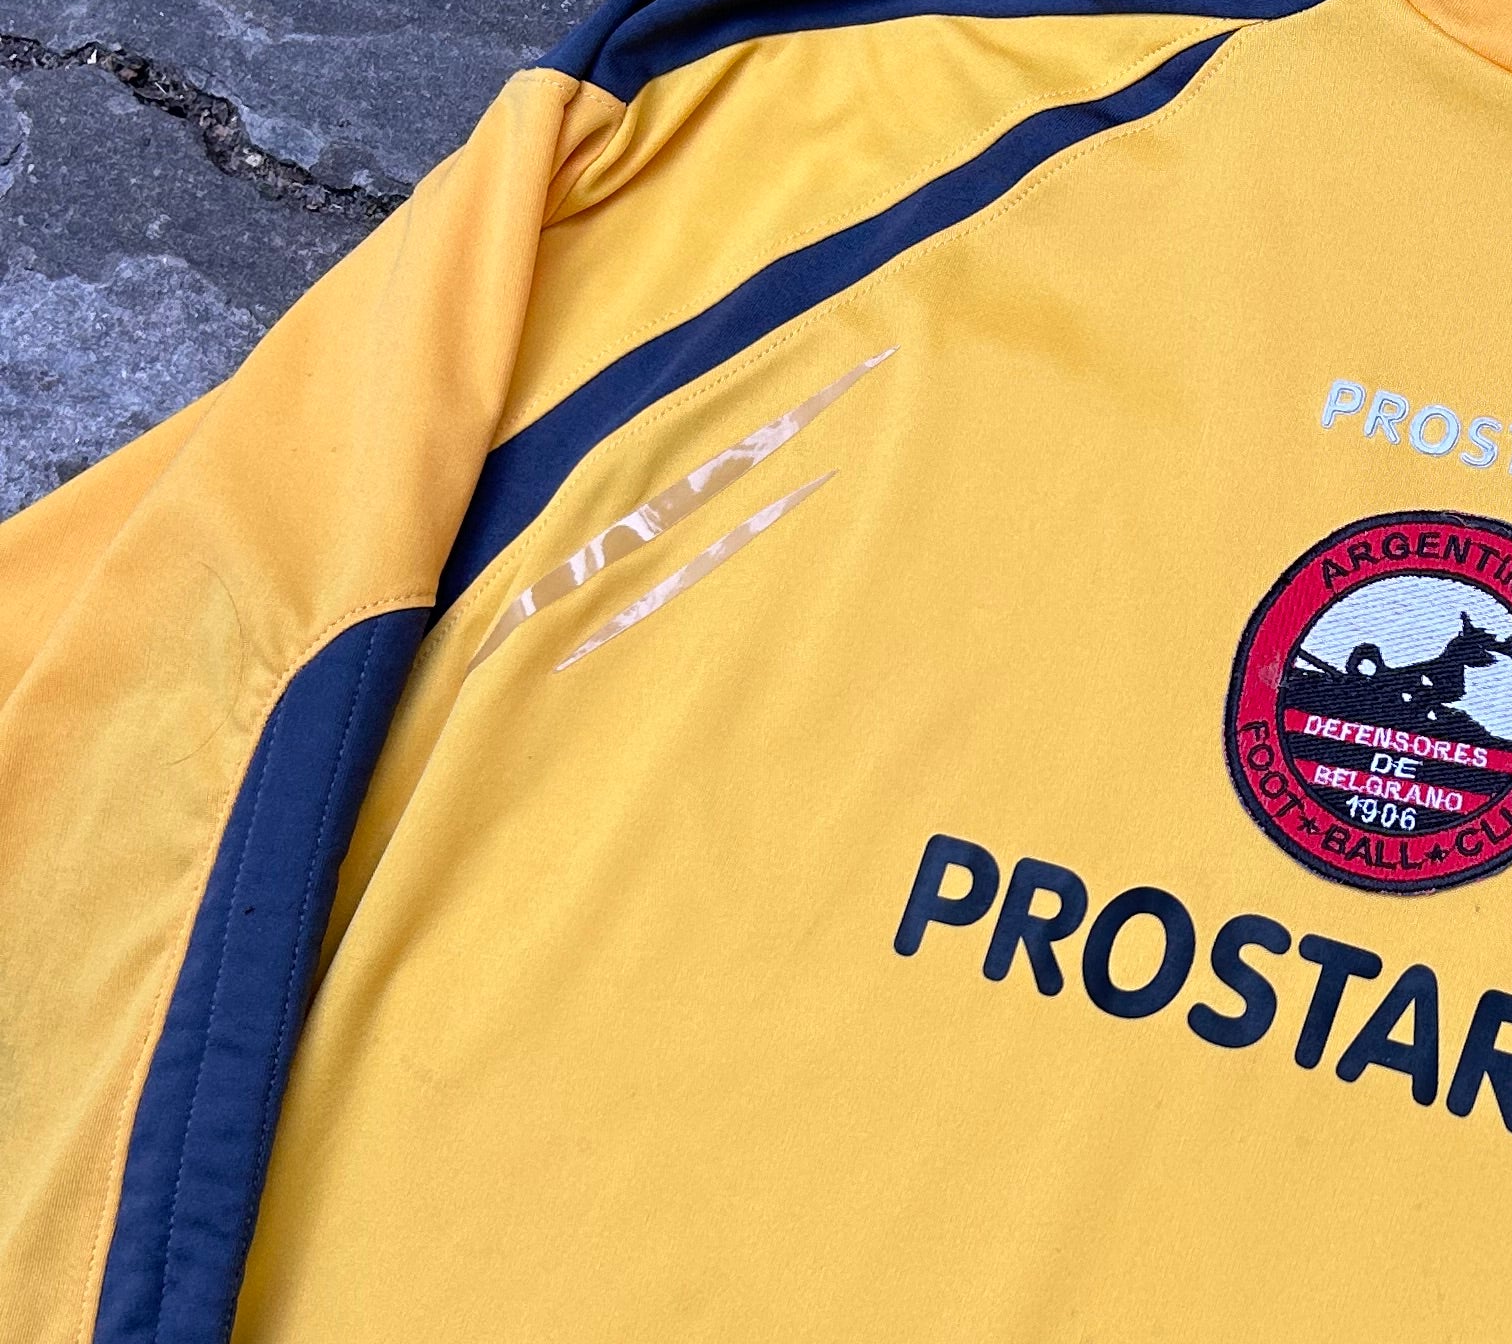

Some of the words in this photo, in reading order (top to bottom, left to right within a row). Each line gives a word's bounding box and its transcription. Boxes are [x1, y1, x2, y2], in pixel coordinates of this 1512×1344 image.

[1303, 714, 1488, 768] DEFENSORES
[1313, 765, 1462, 812] BELGRANO
[1371, 752, 1420, 780] DE
[1241, 720, 1302, 819] FOOT
[1320, 827, 1423, 871] BALL
[1346, 795, 1416, 832] 1906
